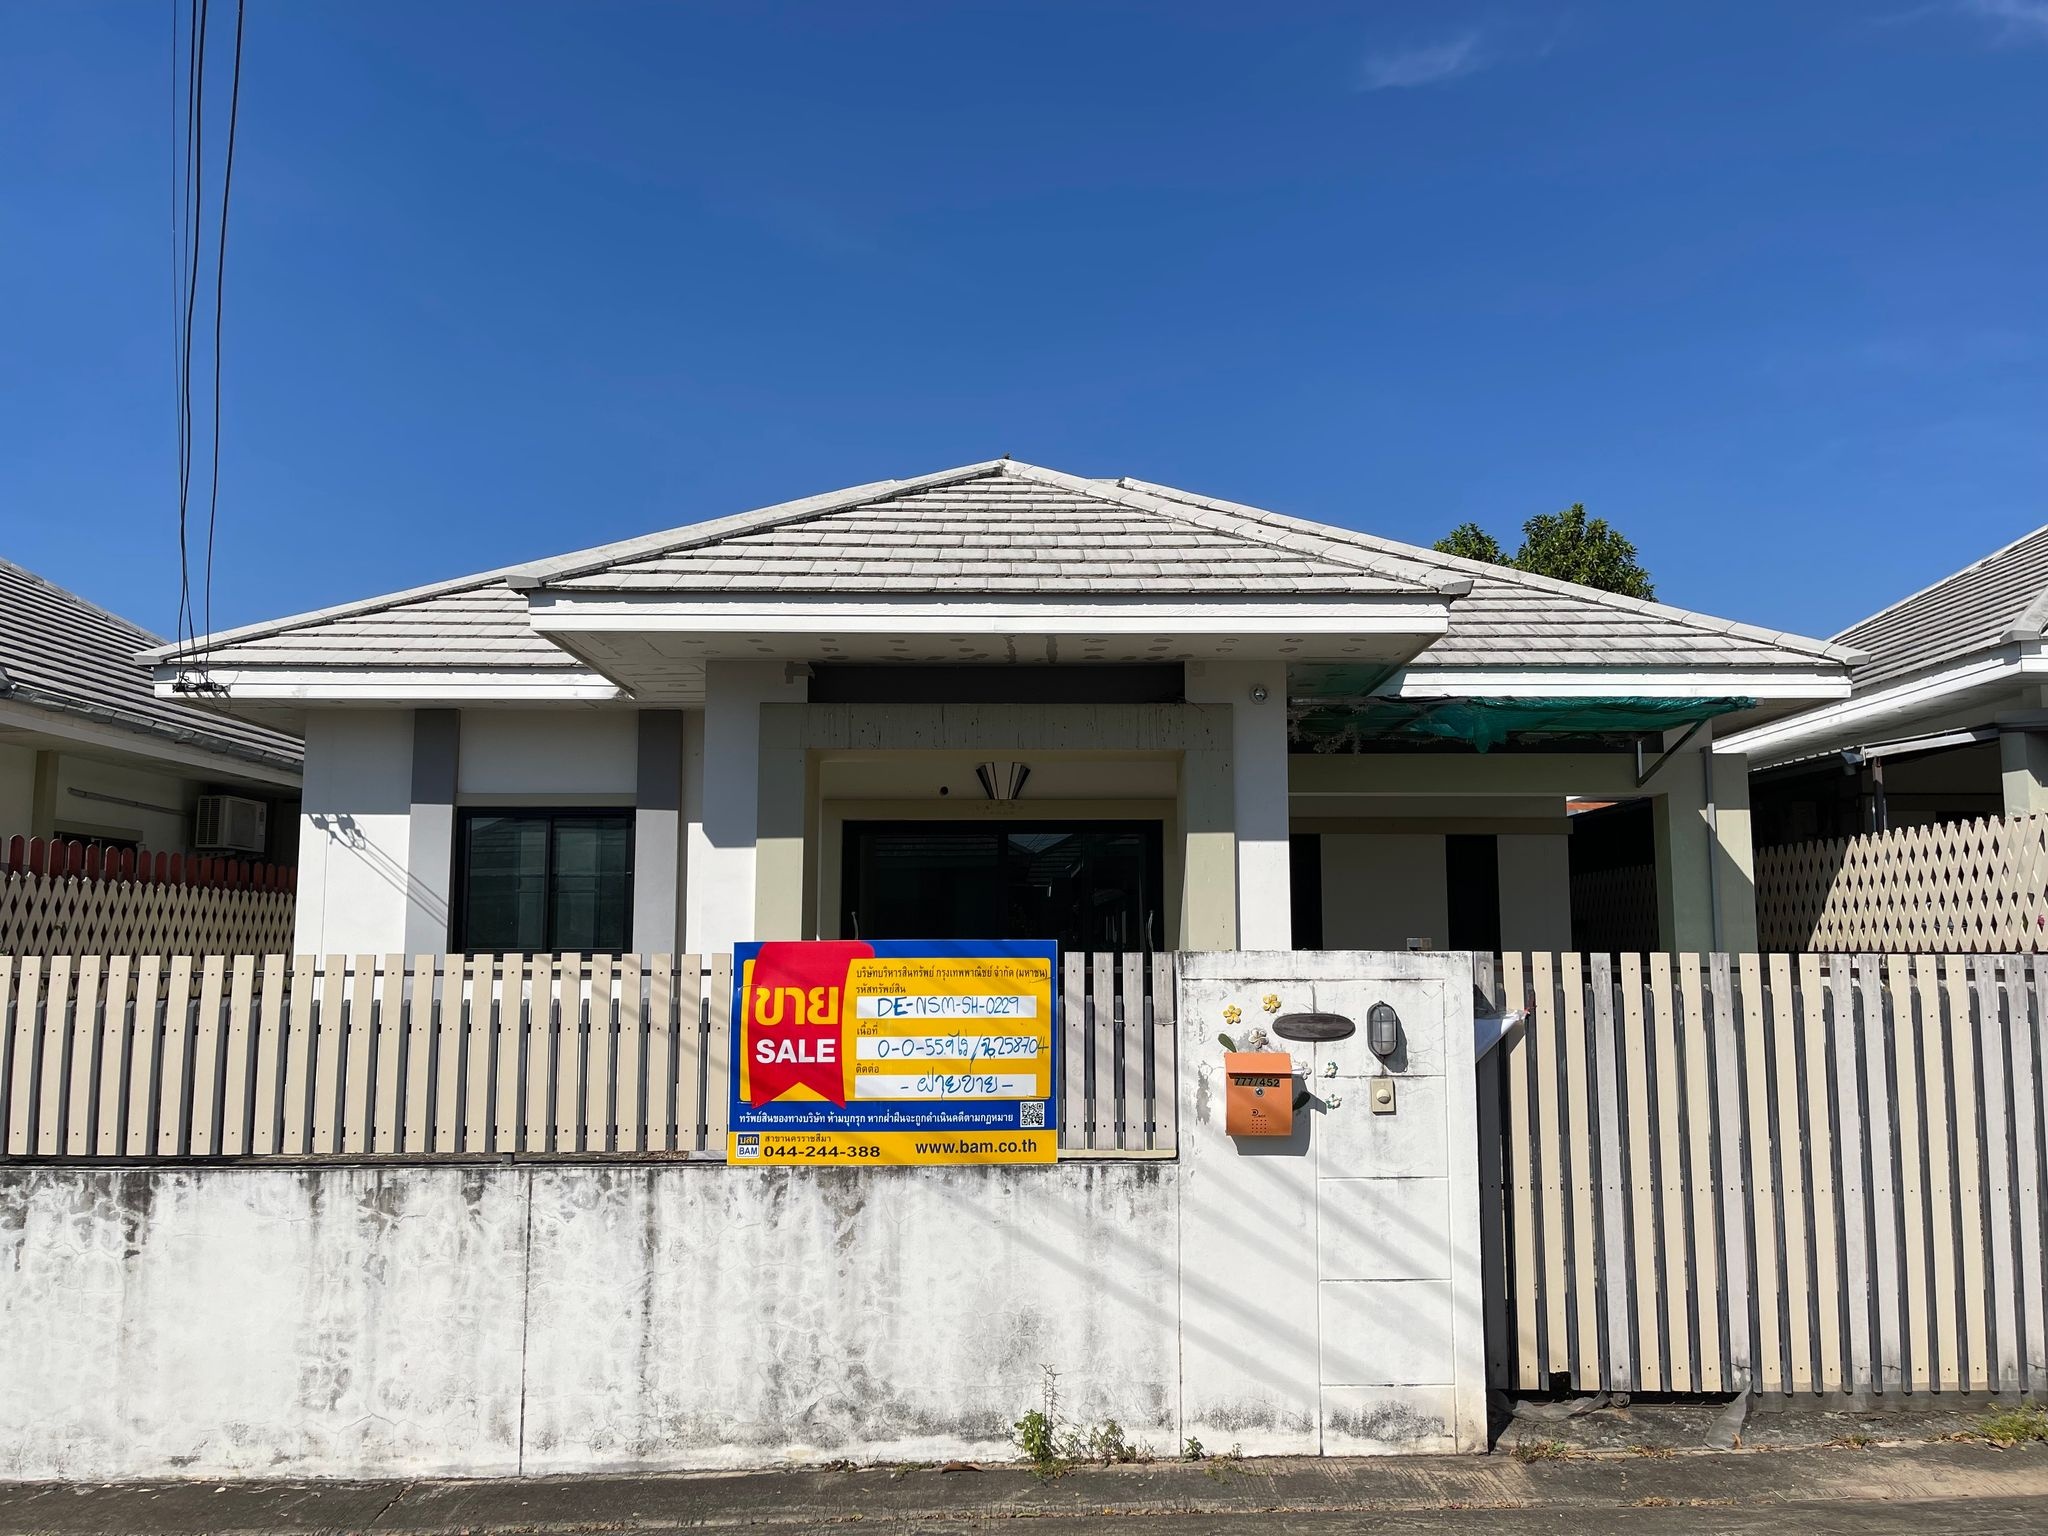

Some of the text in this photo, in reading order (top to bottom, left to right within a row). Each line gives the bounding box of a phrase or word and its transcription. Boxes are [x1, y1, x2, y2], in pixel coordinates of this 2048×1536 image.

[856, 966, 1048, 981] บริษัทบริหารสินทรัพย์ กรุงเทพพาณิชย์ จำกัด (มหาชน)
[856, 982, 906, 994] รหัสทรัพย์สิน
[755, 986, 839, 1026] ขาย
[856, 1023, 878, 1036] เนื้อที่
[756, 1039, 836, 1063] SALE
[855, 1062, 879, 1074] ติดต่อ
[1235, 1077, 1280, 1088] 777/452
[739, 1110, 825, 1123] ทรัพย์สินของทางบริษัท
[827, 1110, 866, 1127] ห้ามบุกรุก
[765, 1133, 832, 1143] สาขานครราชสีมา
[739, 1146, 758, 1155] BAM
[764, 1145, 881, 1158] 044-244-388
[915, 1139, 1037, 1154] www.bam.co.th
